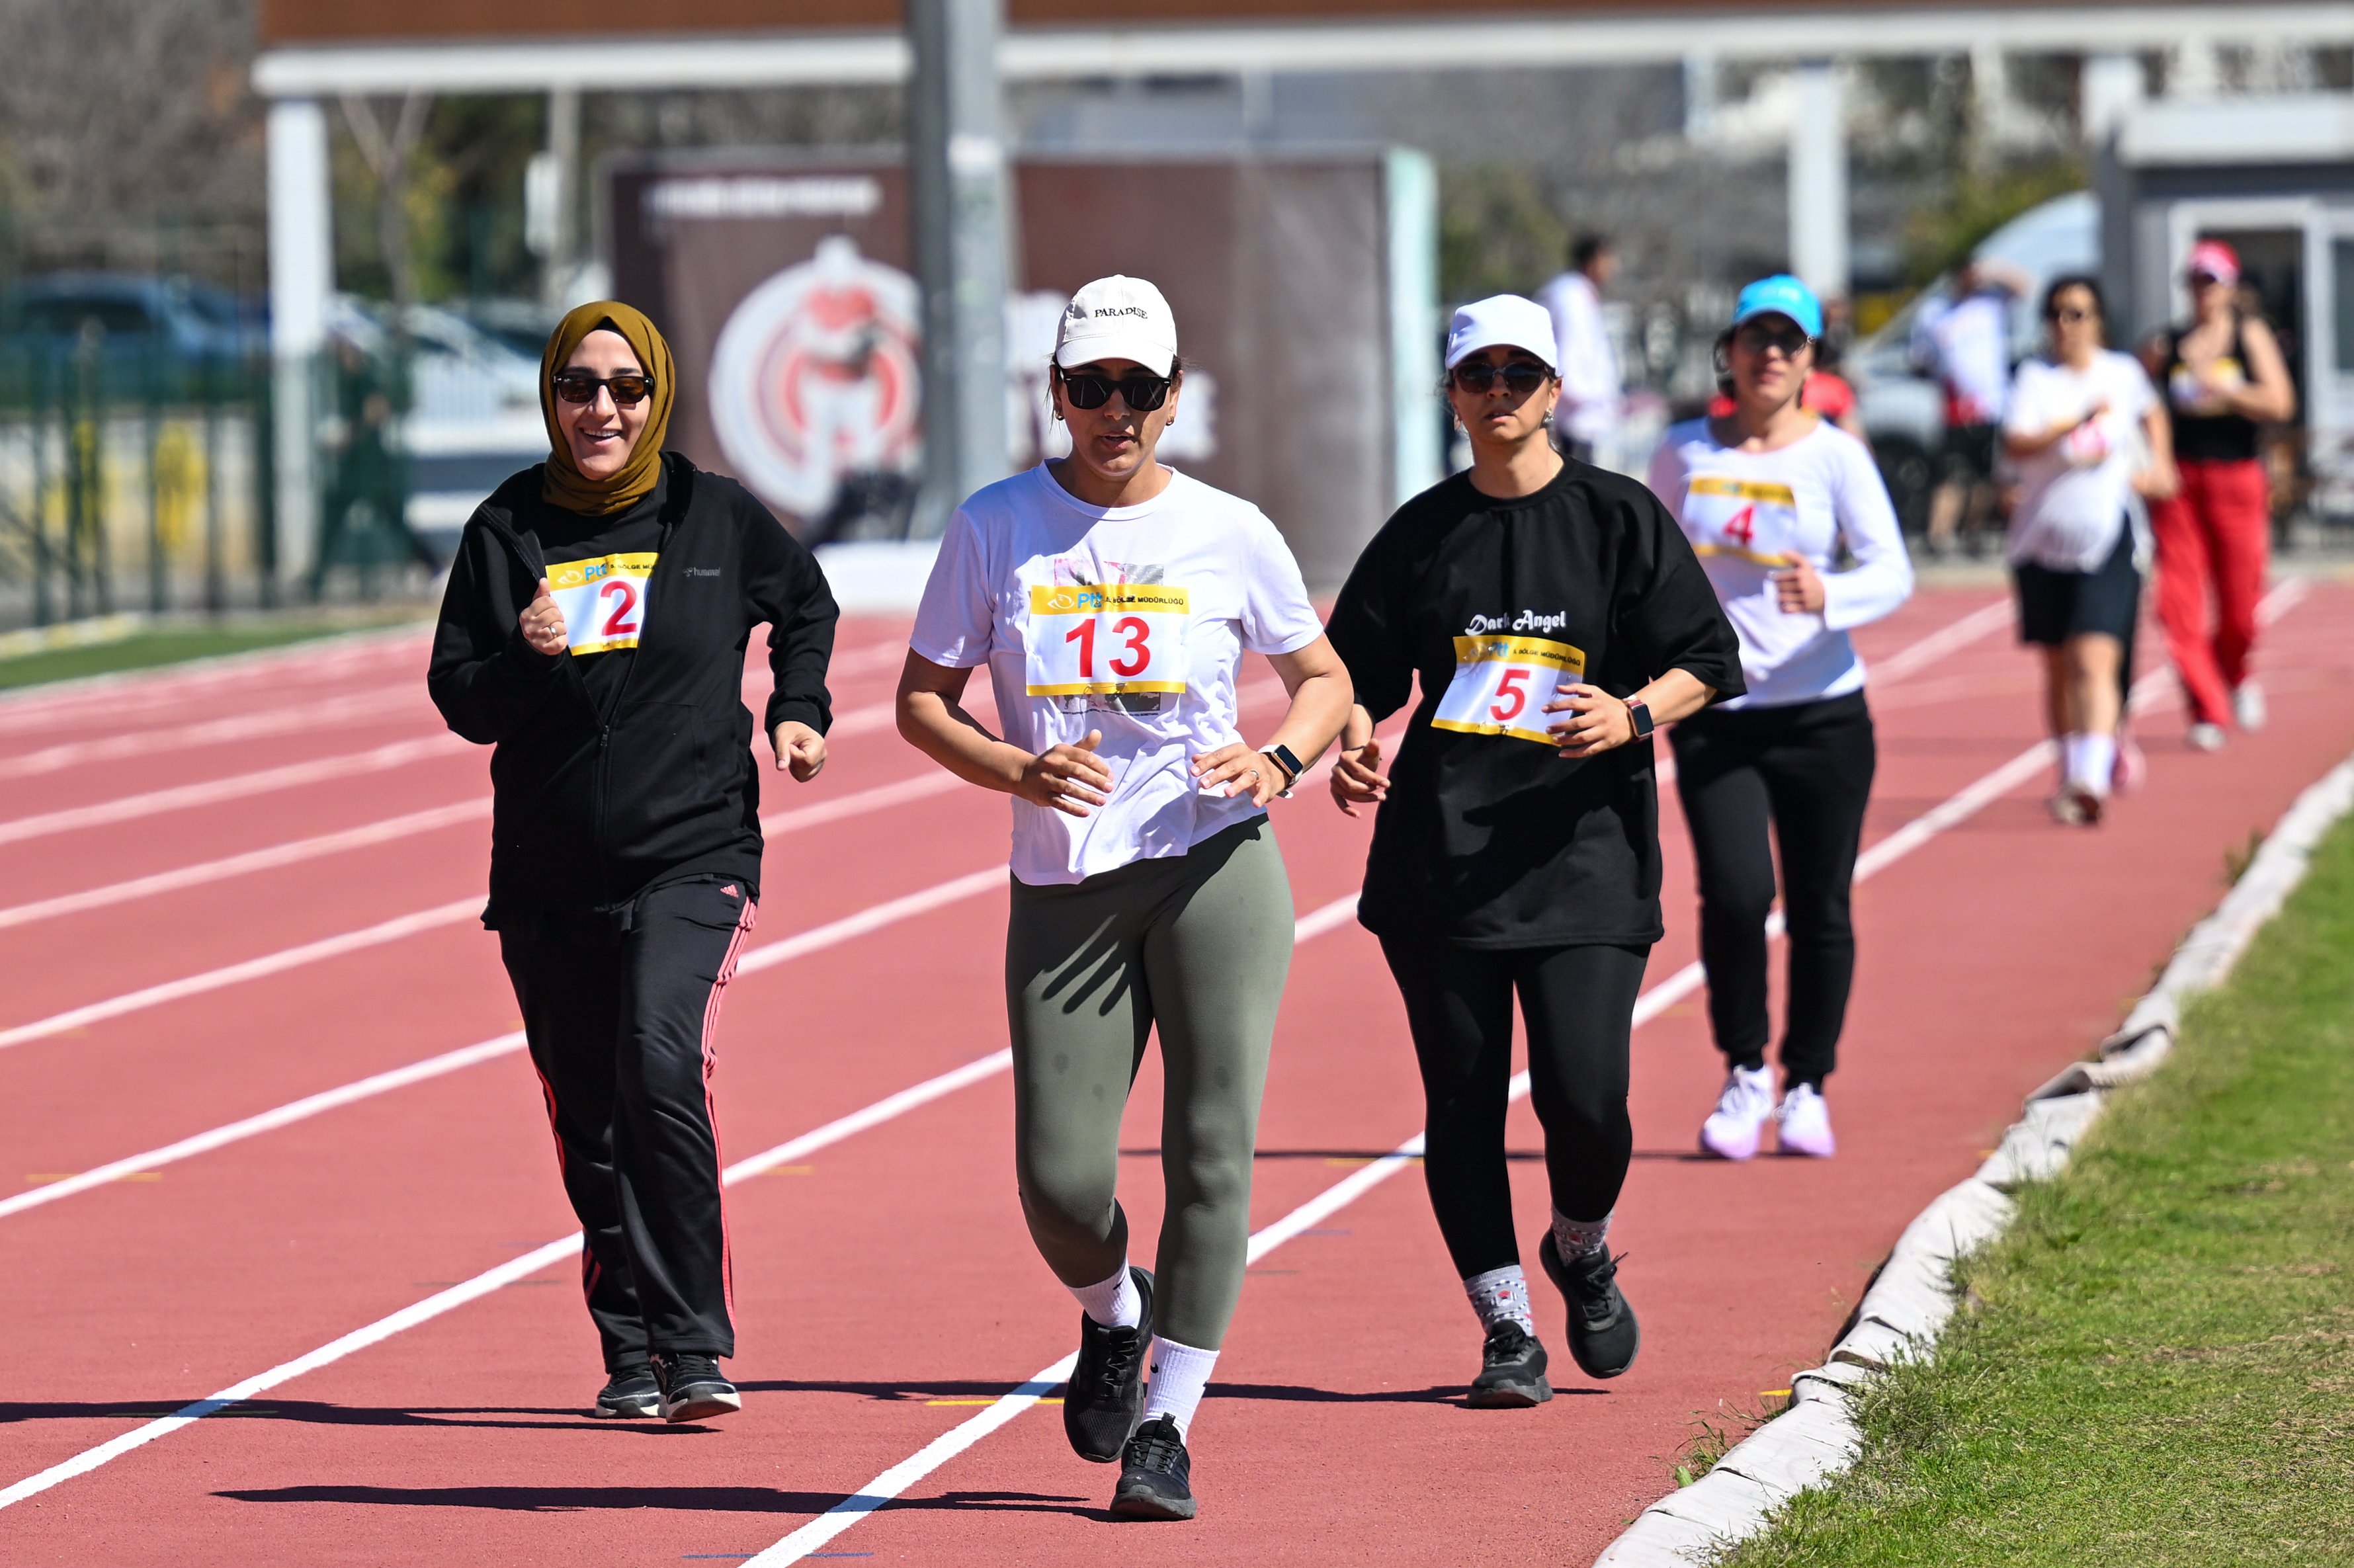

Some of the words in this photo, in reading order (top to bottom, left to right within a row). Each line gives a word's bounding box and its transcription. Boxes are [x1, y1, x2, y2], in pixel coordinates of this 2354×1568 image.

[1094, 307, 1148, 319] PARADISE
[1722, 506, 1754, 546] 4
[600, 580, 637, 636] 2
[1464, 612, 1510, 636] Dark
[1512, 610, 1567, 633] Angel
[1066, 616, 1150, 678] 13
[1490, 669, 1530, 721] 5
